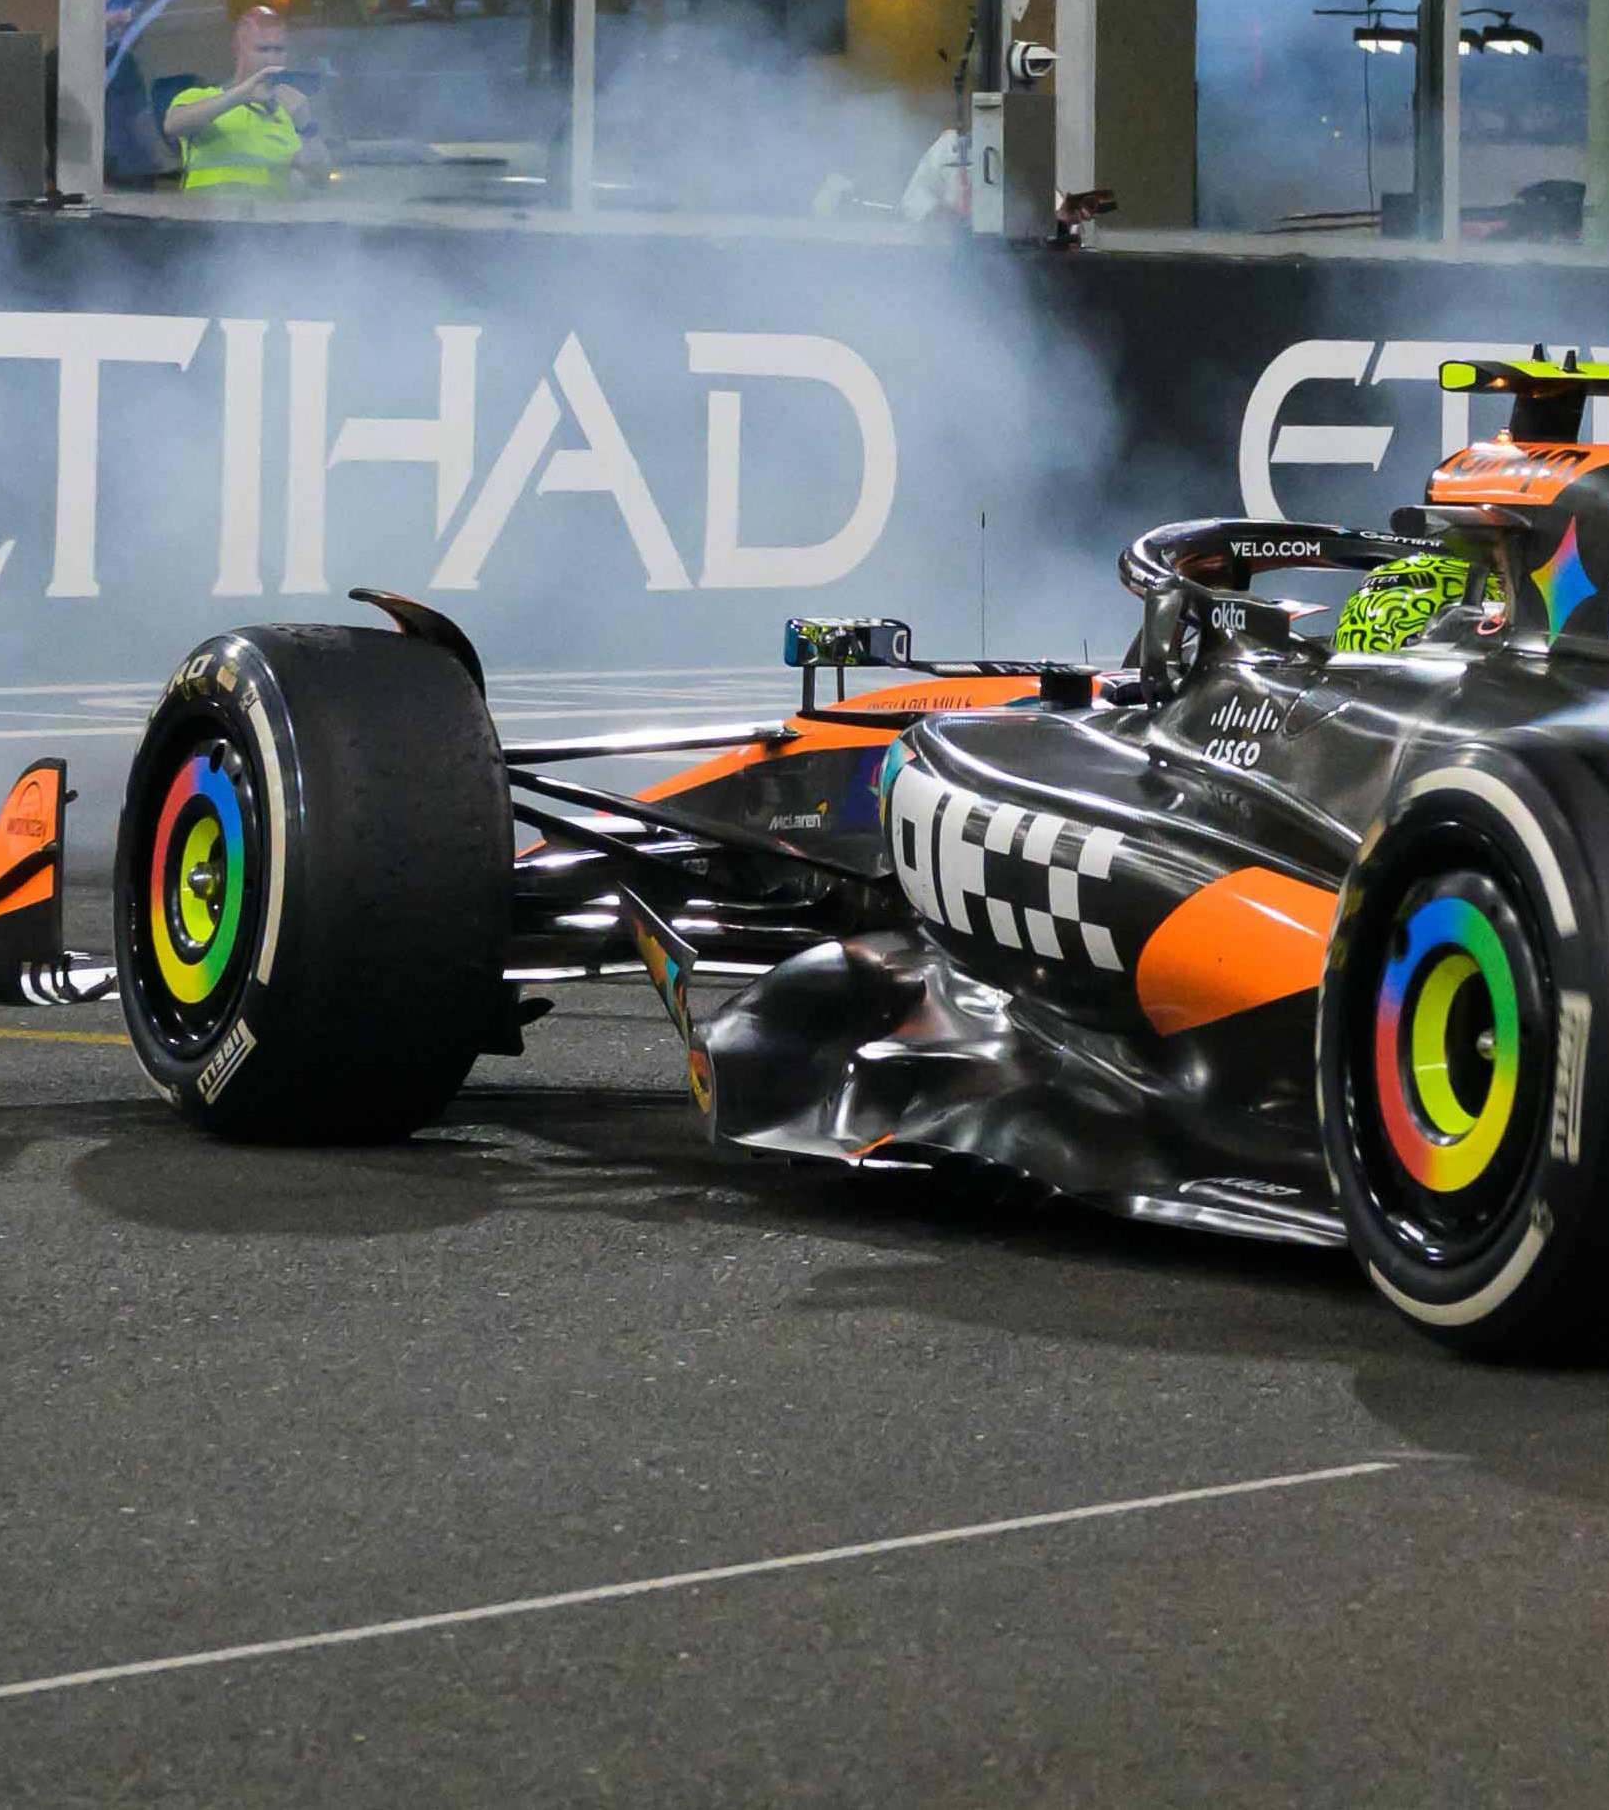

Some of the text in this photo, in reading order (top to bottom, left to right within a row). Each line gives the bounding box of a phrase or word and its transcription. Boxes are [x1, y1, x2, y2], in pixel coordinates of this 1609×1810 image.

[1229, 540, 1321, 557] VELO.COM
[1211, 601, 1246, 630] okta
[768, 813, 821, 831] McLaren
